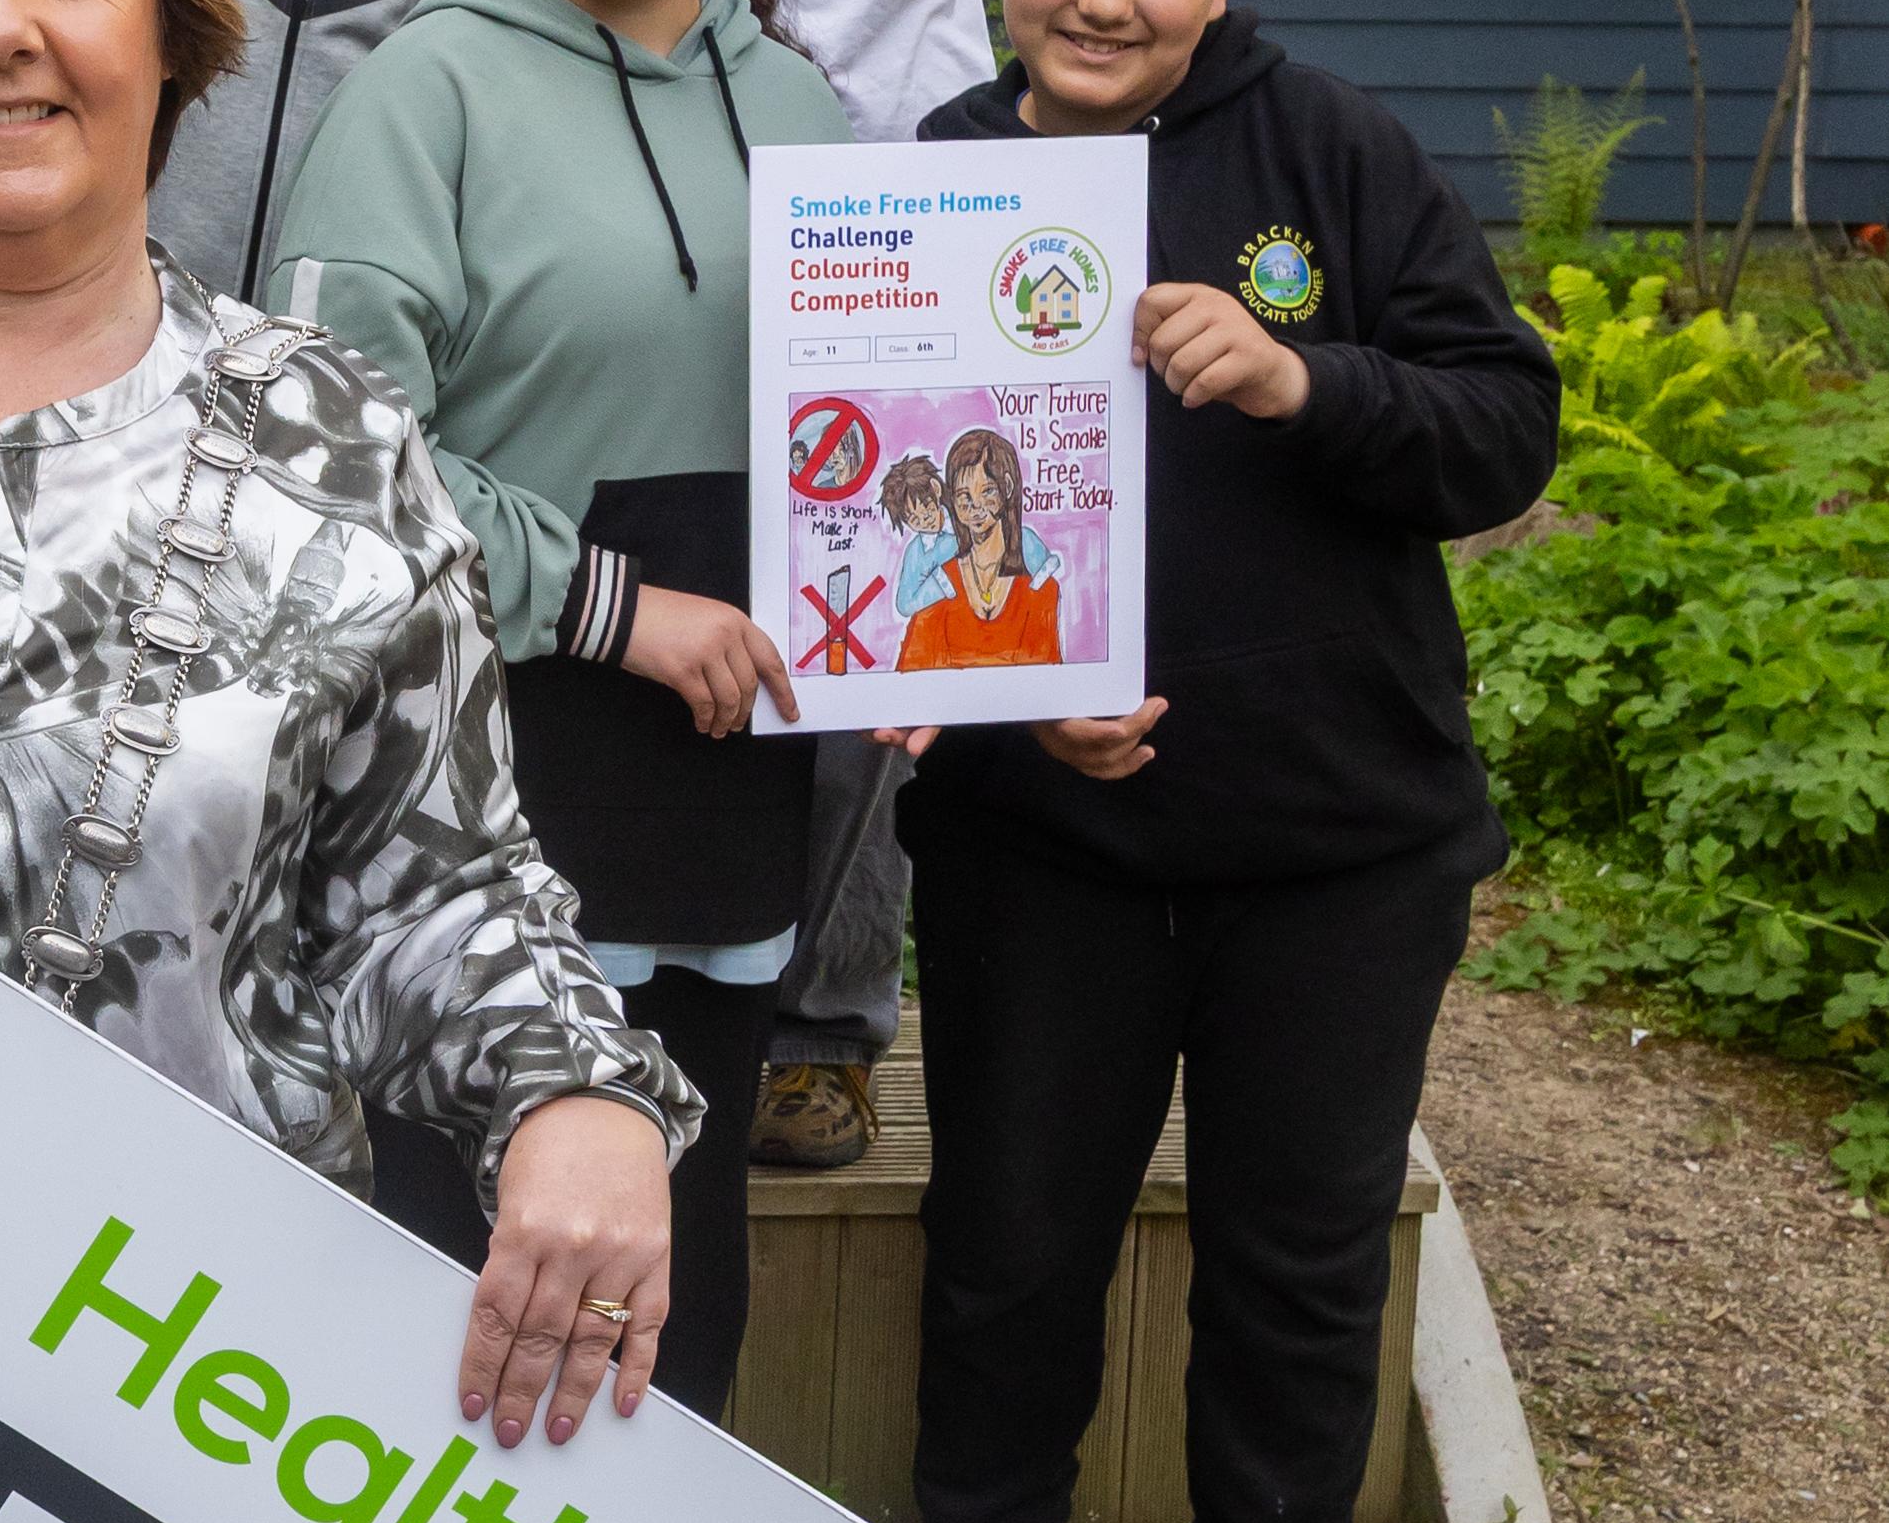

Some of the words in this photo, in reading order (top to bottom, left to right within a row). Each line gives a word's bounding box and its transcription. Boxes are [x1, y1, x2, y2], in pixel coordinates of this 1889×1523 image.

[790, 194, 871, 217] Smoke
[878, 193, 932, 216] Free
[939, 190, 1022, 213] Homes
[790, 226, 913, 253] Challenge
[1237, 225, 1315, 266] BRACKEN
[790, 256, 910, 283] Colouring
[999, 248, 1028, 297] SMOKE
[1028, 238, 1068, 256] FREE
[1068, 245, 1099, 294] HOMES
[790, 287, 939, 316] Competition
[1239, 281, 1288, 323] EDUCATE
[1291, 268, 1324, 323] TOGETHER
[826, 345, 837, 356] 11
[916, 342, 934, 352] 6th
[991, 385, 1039, 417] Your
[1049, 383, 1107, 416] Future
[1020, 422, 1036, 450] Is
[1049, 419, 1107, 451] Smoke
[1037, 458, 1085, 489] Free,
[792, 500, 818, 517] Life
[1022, 486, 1064, 513] Start
[812, 520, 842, 536] Make
[848, 522, 859, 535] it
